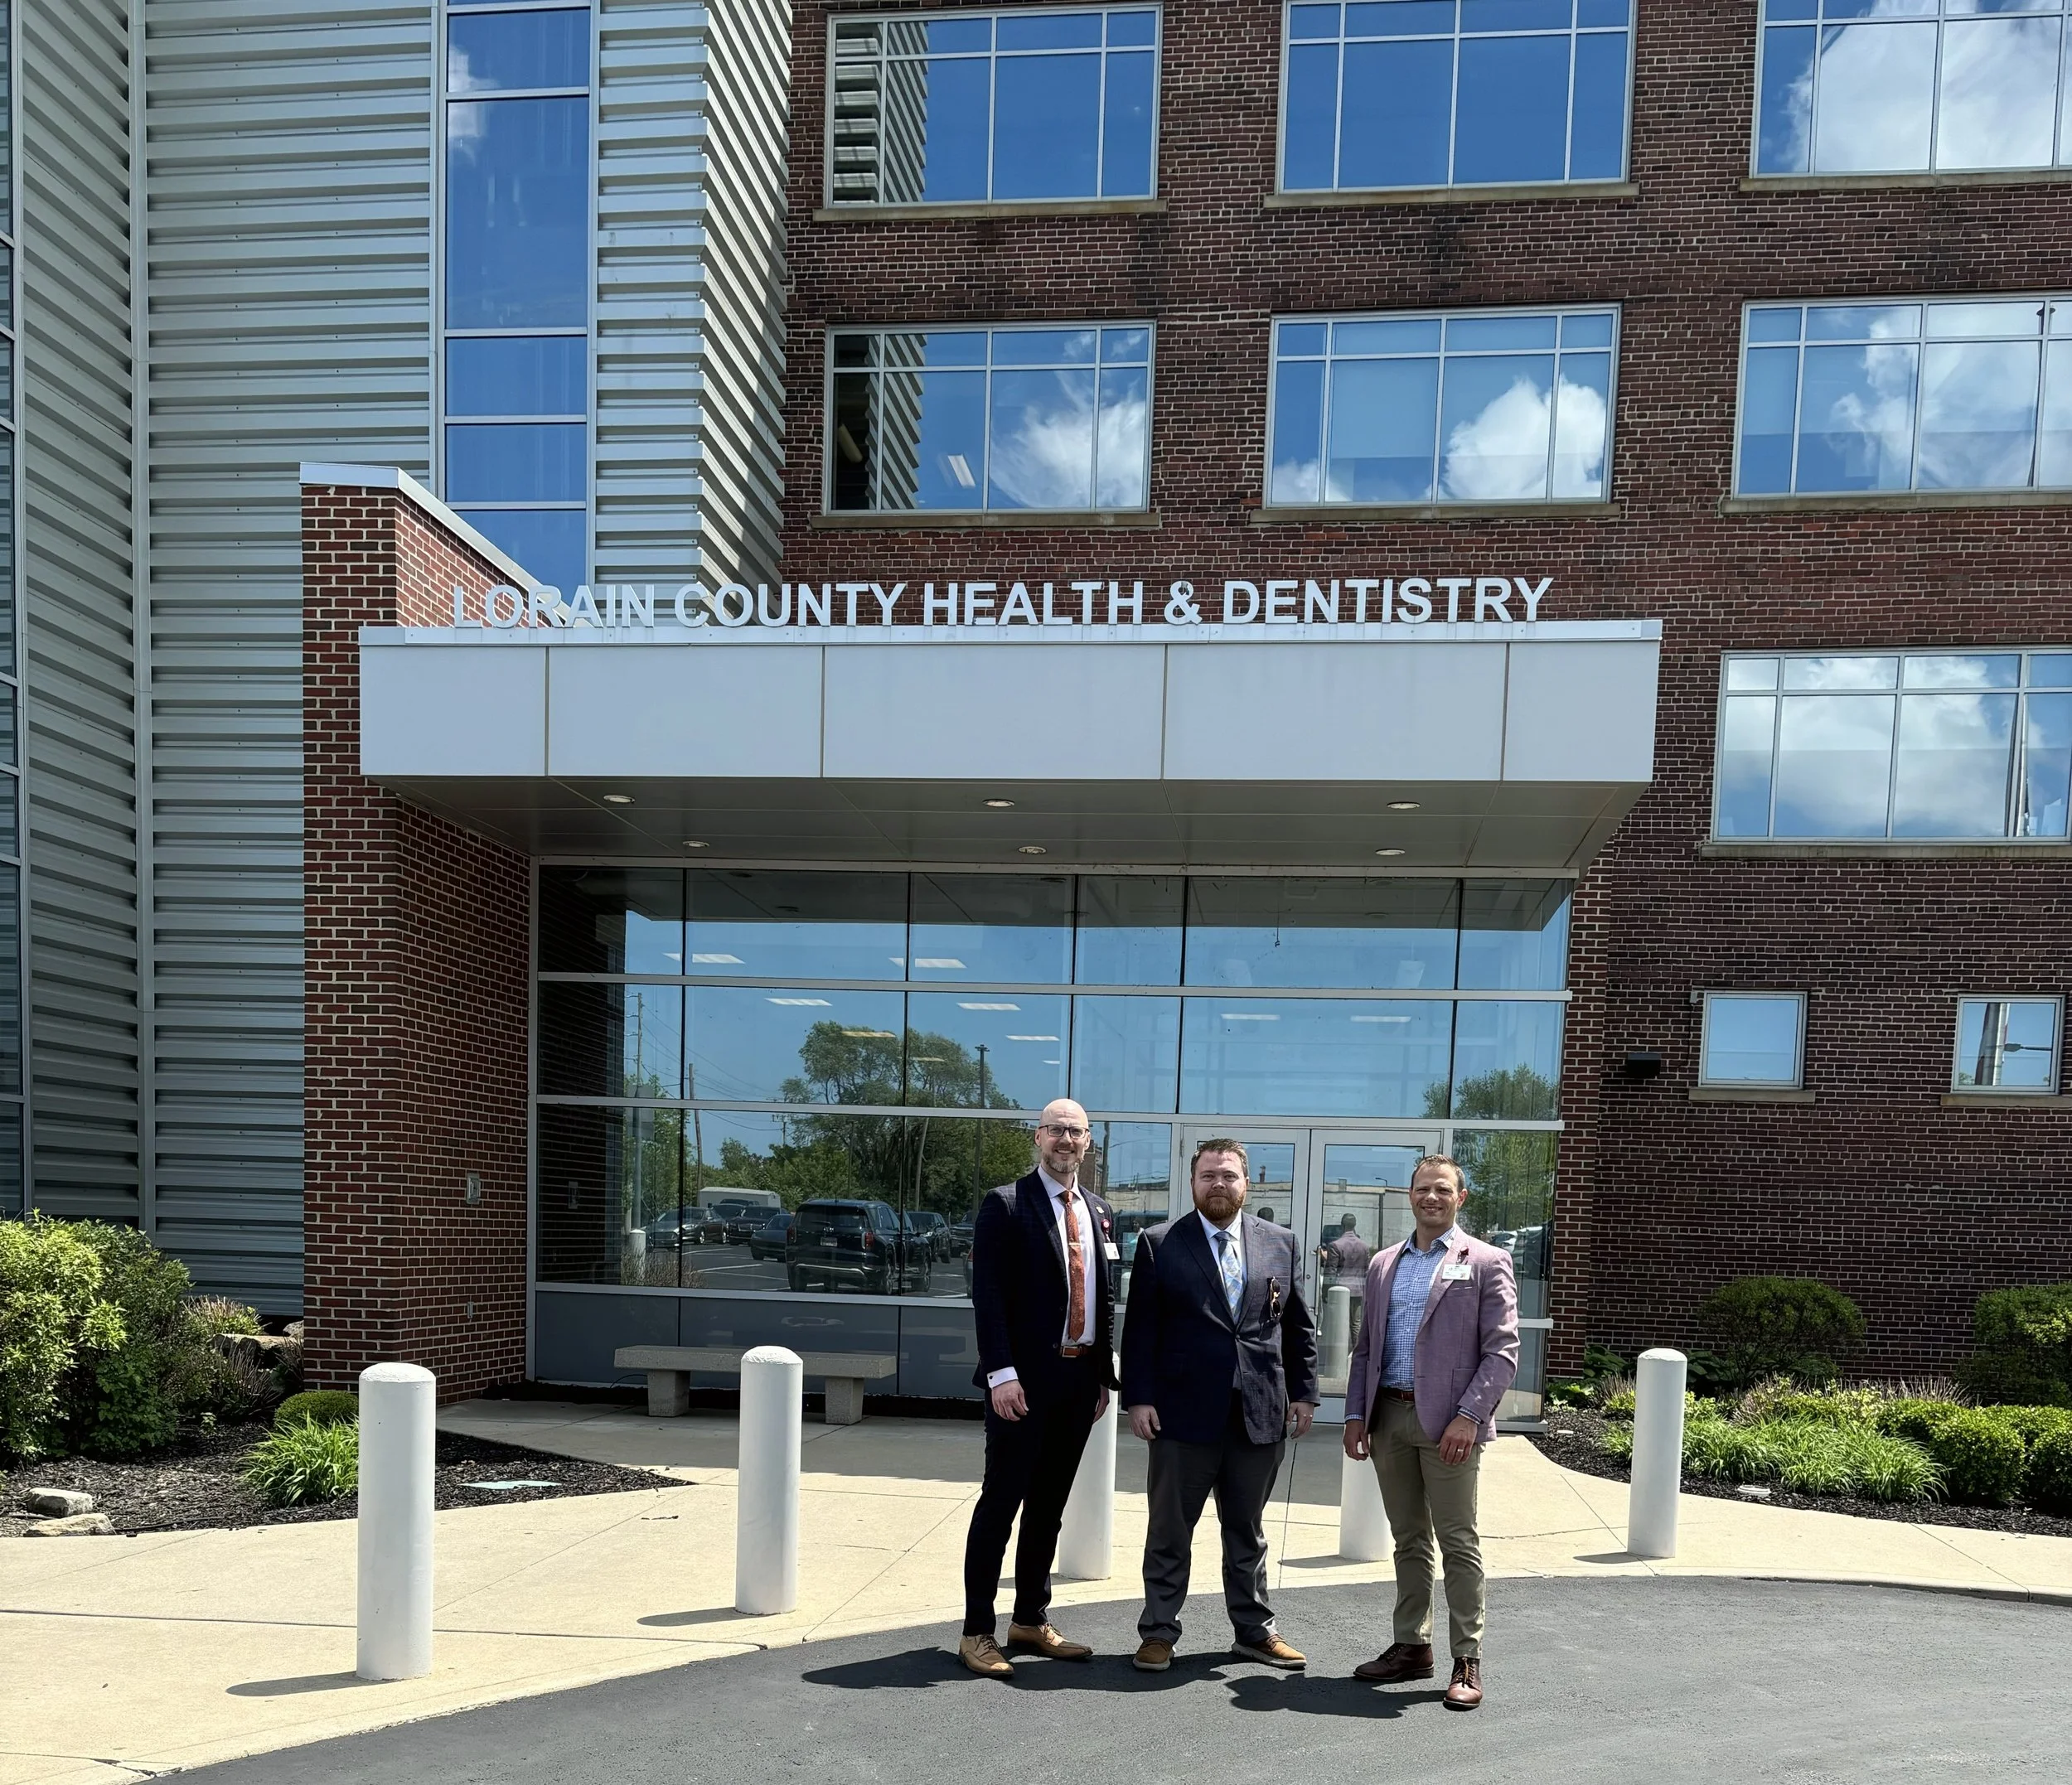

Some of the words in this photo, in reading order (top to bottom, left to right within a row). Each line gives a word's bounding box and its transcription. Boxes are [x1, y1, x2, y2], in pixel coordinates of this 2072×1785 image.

[454, 584, 655, 628] LORAIN
[674, 583, 907, 627] COUNTY
[923, 582, 1144, 626] HEALTH
[1164, 581, 1203, 626] &
[1222, 577, 1554, 625] DENTISTRY
